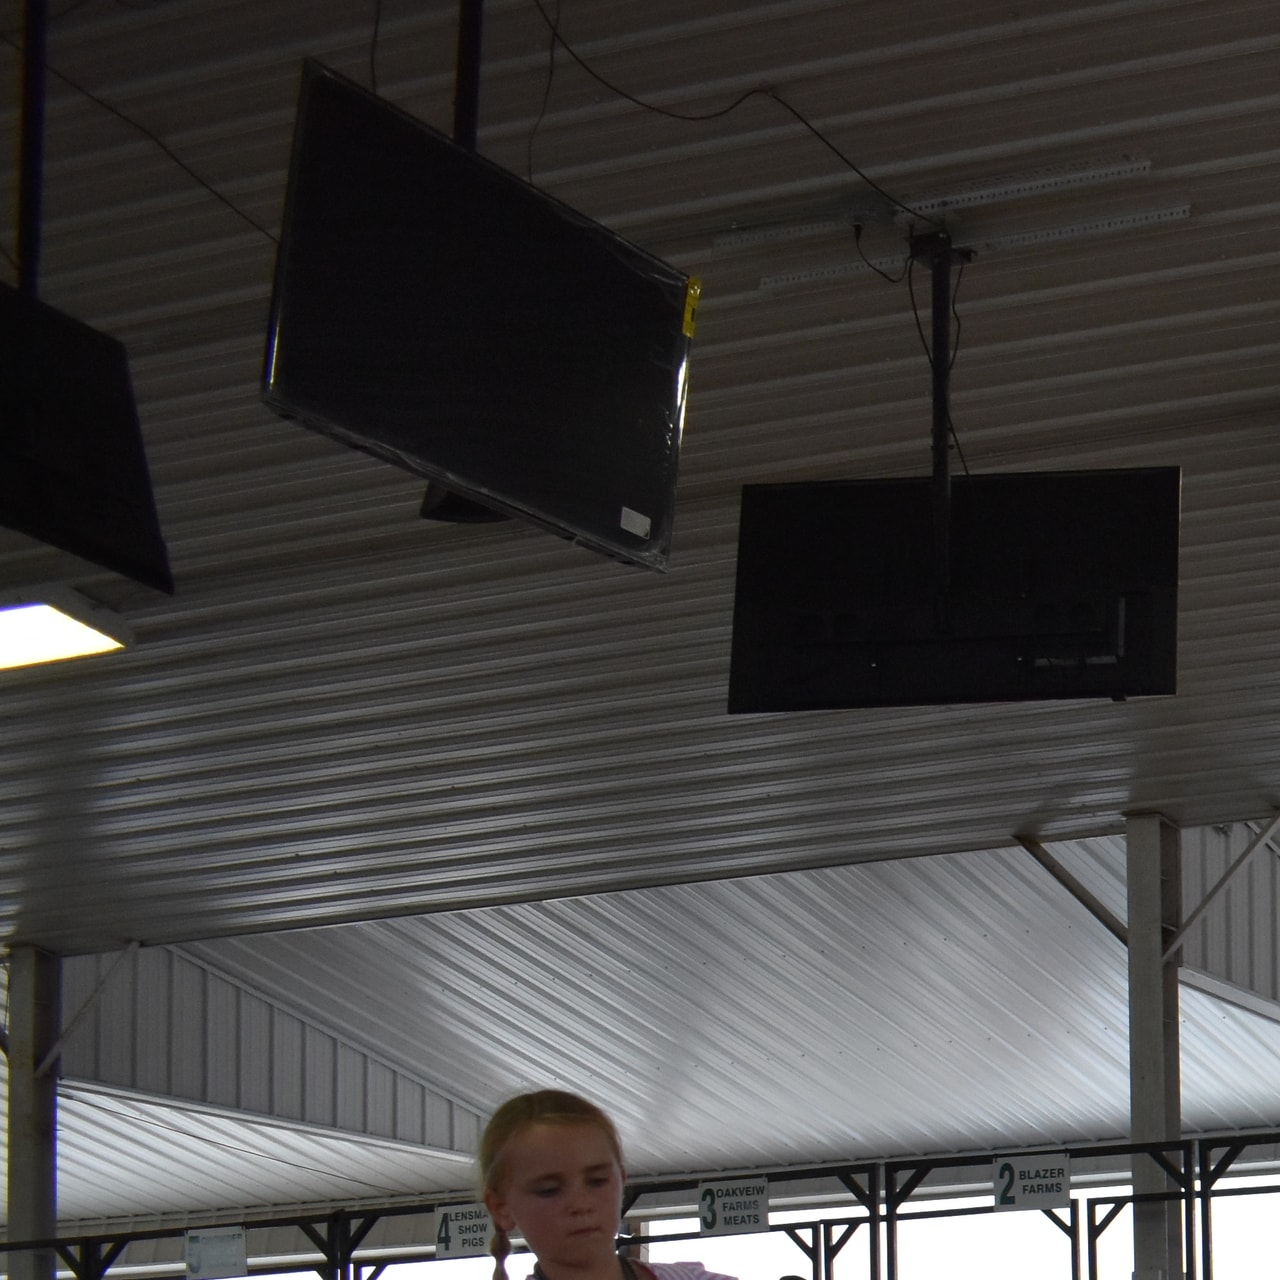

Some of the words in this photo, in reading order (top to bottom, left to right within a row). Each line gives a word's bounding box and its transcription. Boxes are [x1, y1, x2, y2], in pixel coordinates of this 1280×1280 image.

[1019, 1168, 1065, 1180] BLAZER
[999, 1162, 1015, 1205] 2
[1022, 1183, 1062, 1194] FARMS
[716, 1185, 765, 1198] OAKVEIW
[702, 1188, 717, 1230] 3
[722, 1200, 759, 1211] FARMS
[724, 1214, 760, 1225] MEATS
[437, 1212, 451, 1251] 4
[458, 1223, 488, 1235] SHOW
[462, 1237, 485, 1248] PIGS
